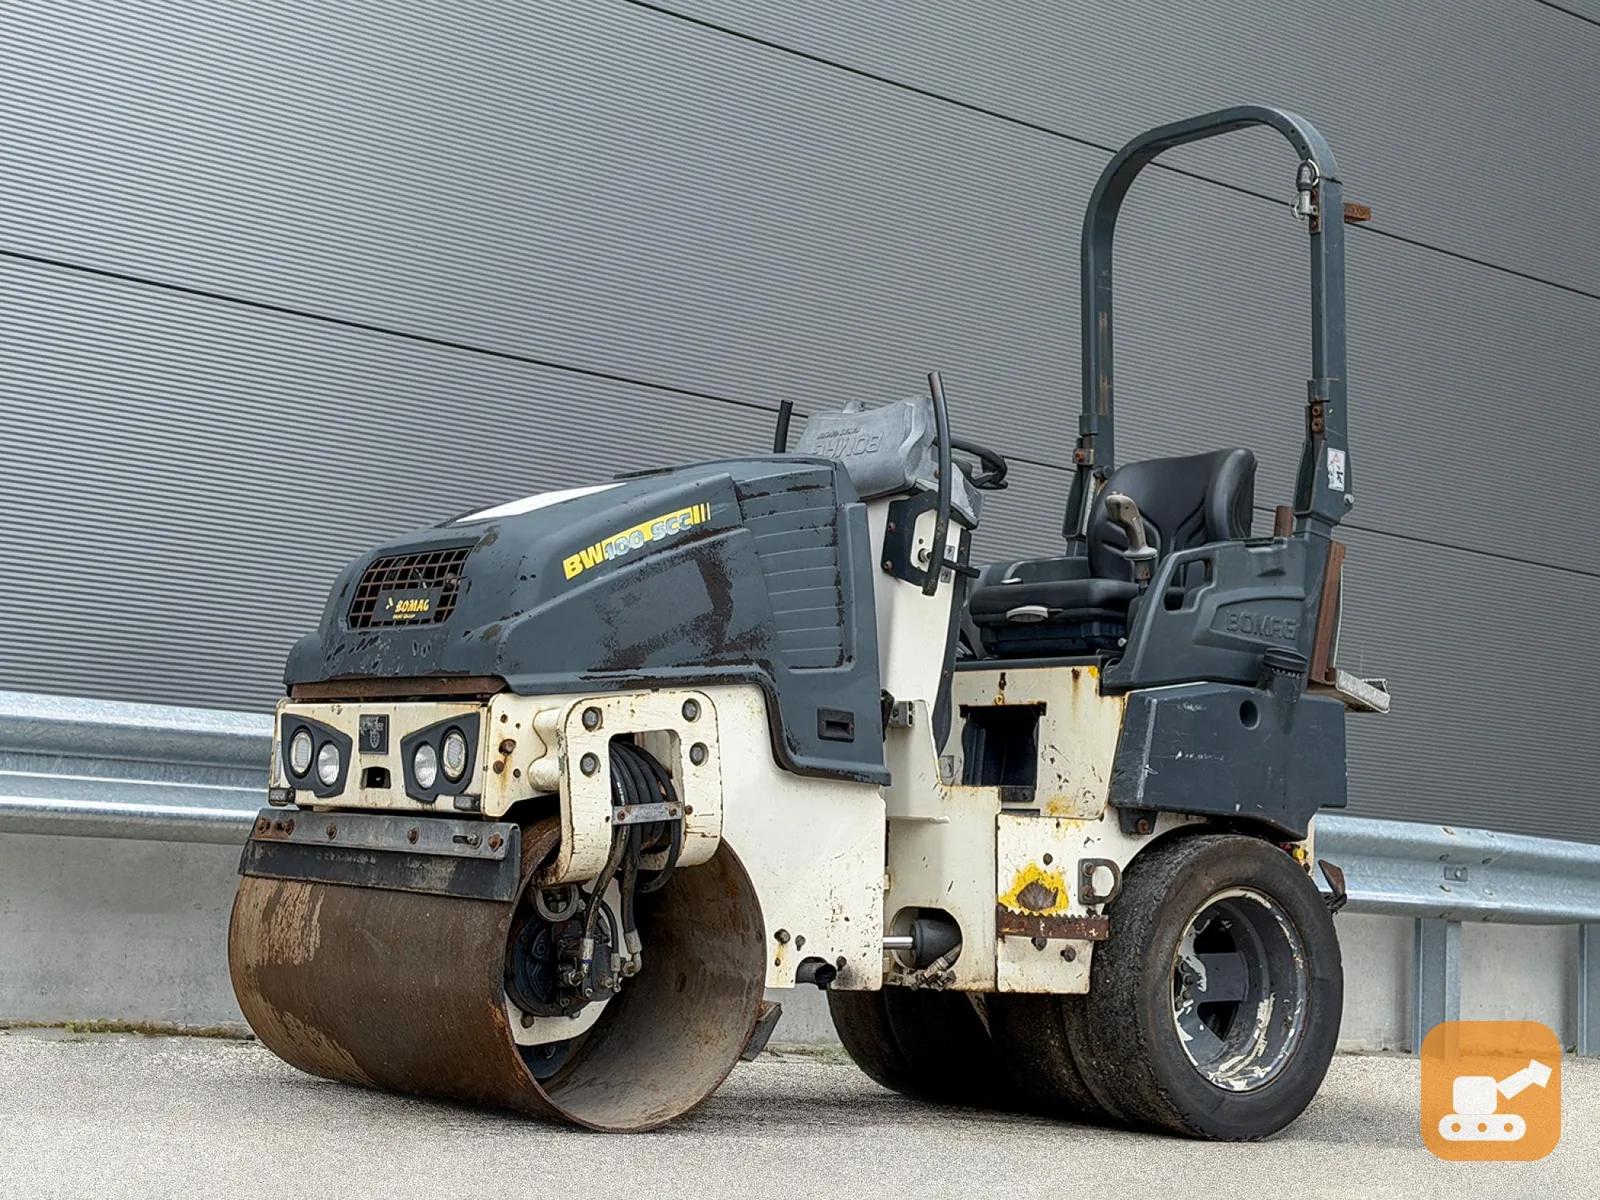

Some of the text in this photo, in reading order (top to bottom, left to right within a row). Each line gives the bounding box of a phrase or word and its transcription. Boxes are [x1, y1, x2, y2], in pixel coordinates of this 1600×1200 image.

[651, 512, 692, 542] SCC
[394, 599, 430, 613] BOMAG
[1224, 611, 1298, 641] BOMAG
